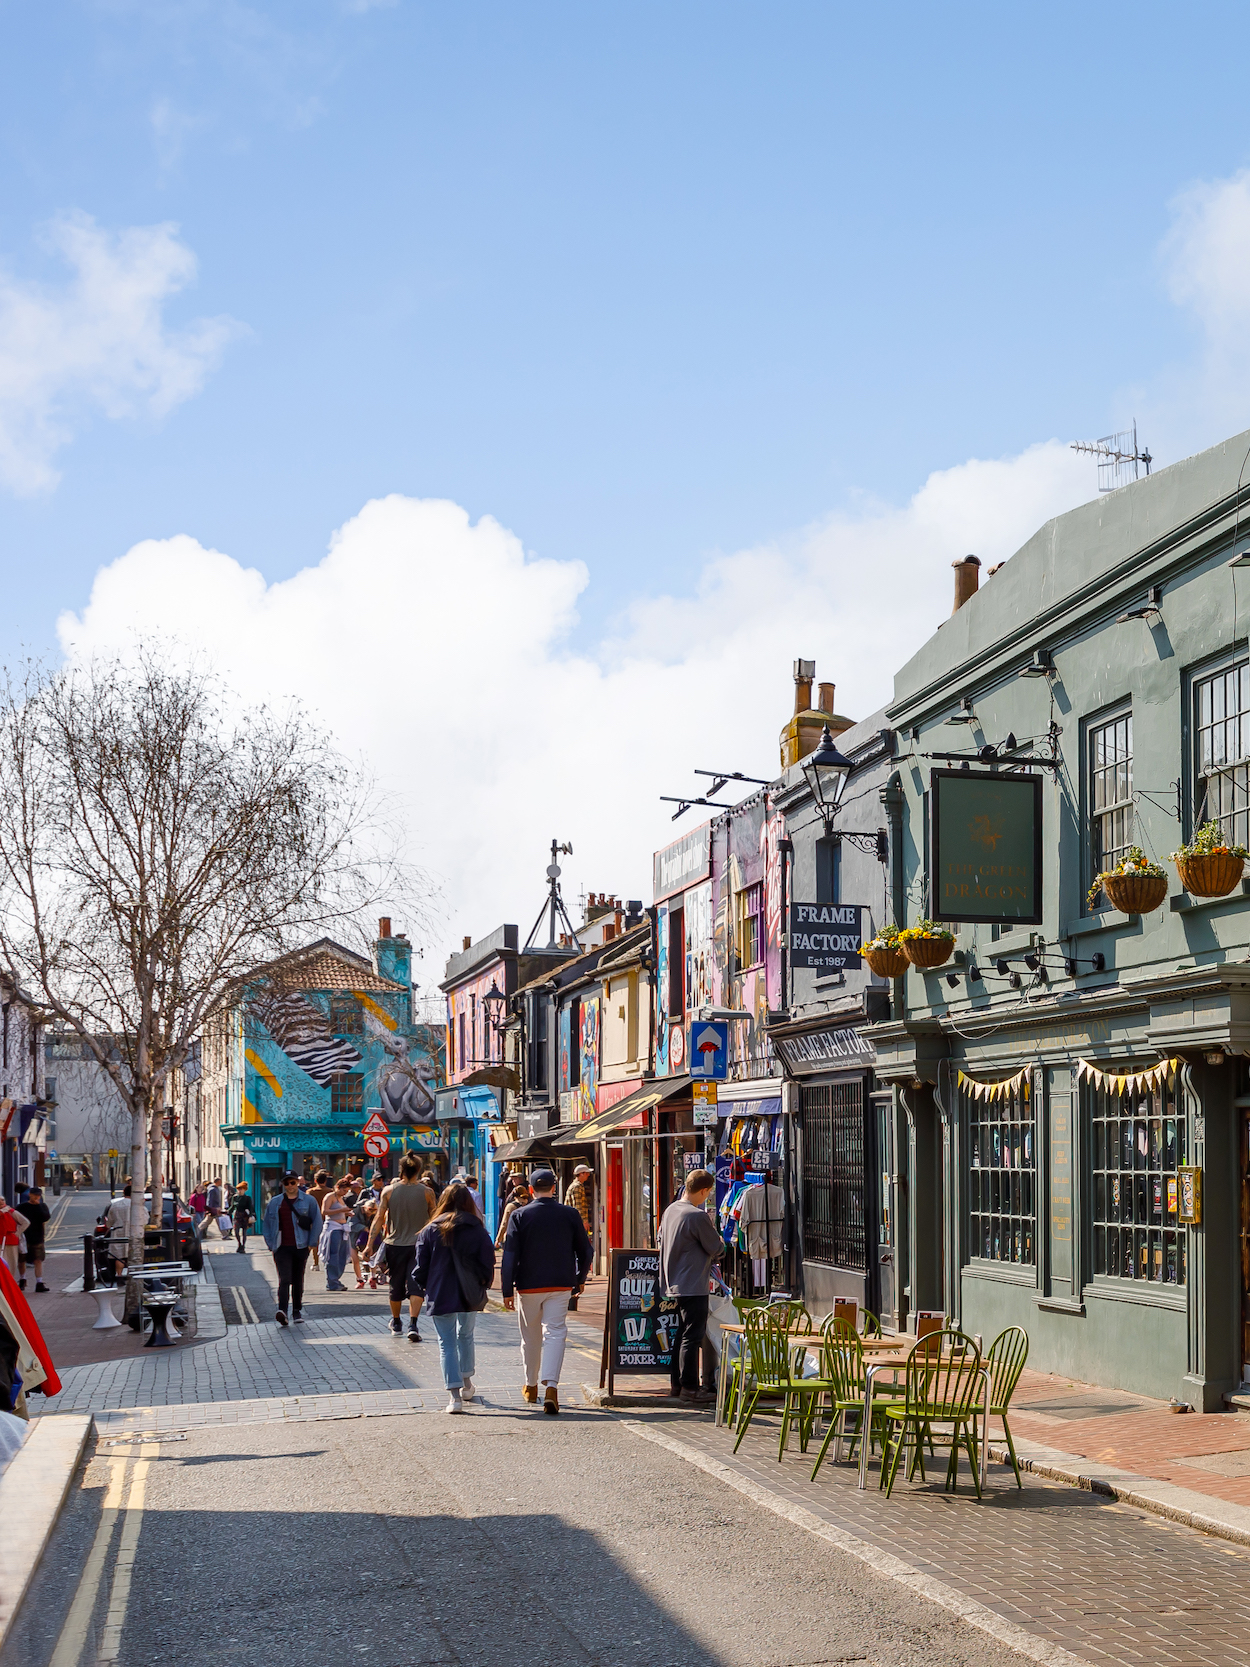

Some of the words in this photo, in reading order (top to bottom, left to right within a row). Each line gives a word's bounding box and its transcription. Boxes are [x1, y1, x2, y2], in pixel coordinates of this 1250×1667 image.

[946, 863, 975, 875] THE
[979, 865, 1026, 877] GREEN
[945, 883, 1027, 900] DRAGON
[797, 905, 856, 924] FRAME
[792, 933, 860, 951] FACTORY
[807, 956, 823, 966] Est
[825, 956, 847, 966] 1987
[1062, 1019, 1109, 1046] DRAGON
[782, 1031, 827, 1063] FRAME
[684, 1154, 701, 1164] £10
[754, 1152, 770, 1164] £5
[620, 1278, 654, 1296] QUIZ
[623, 1317, 647, 1341] DJ
[620, 1354, 656, 1364] POKER
